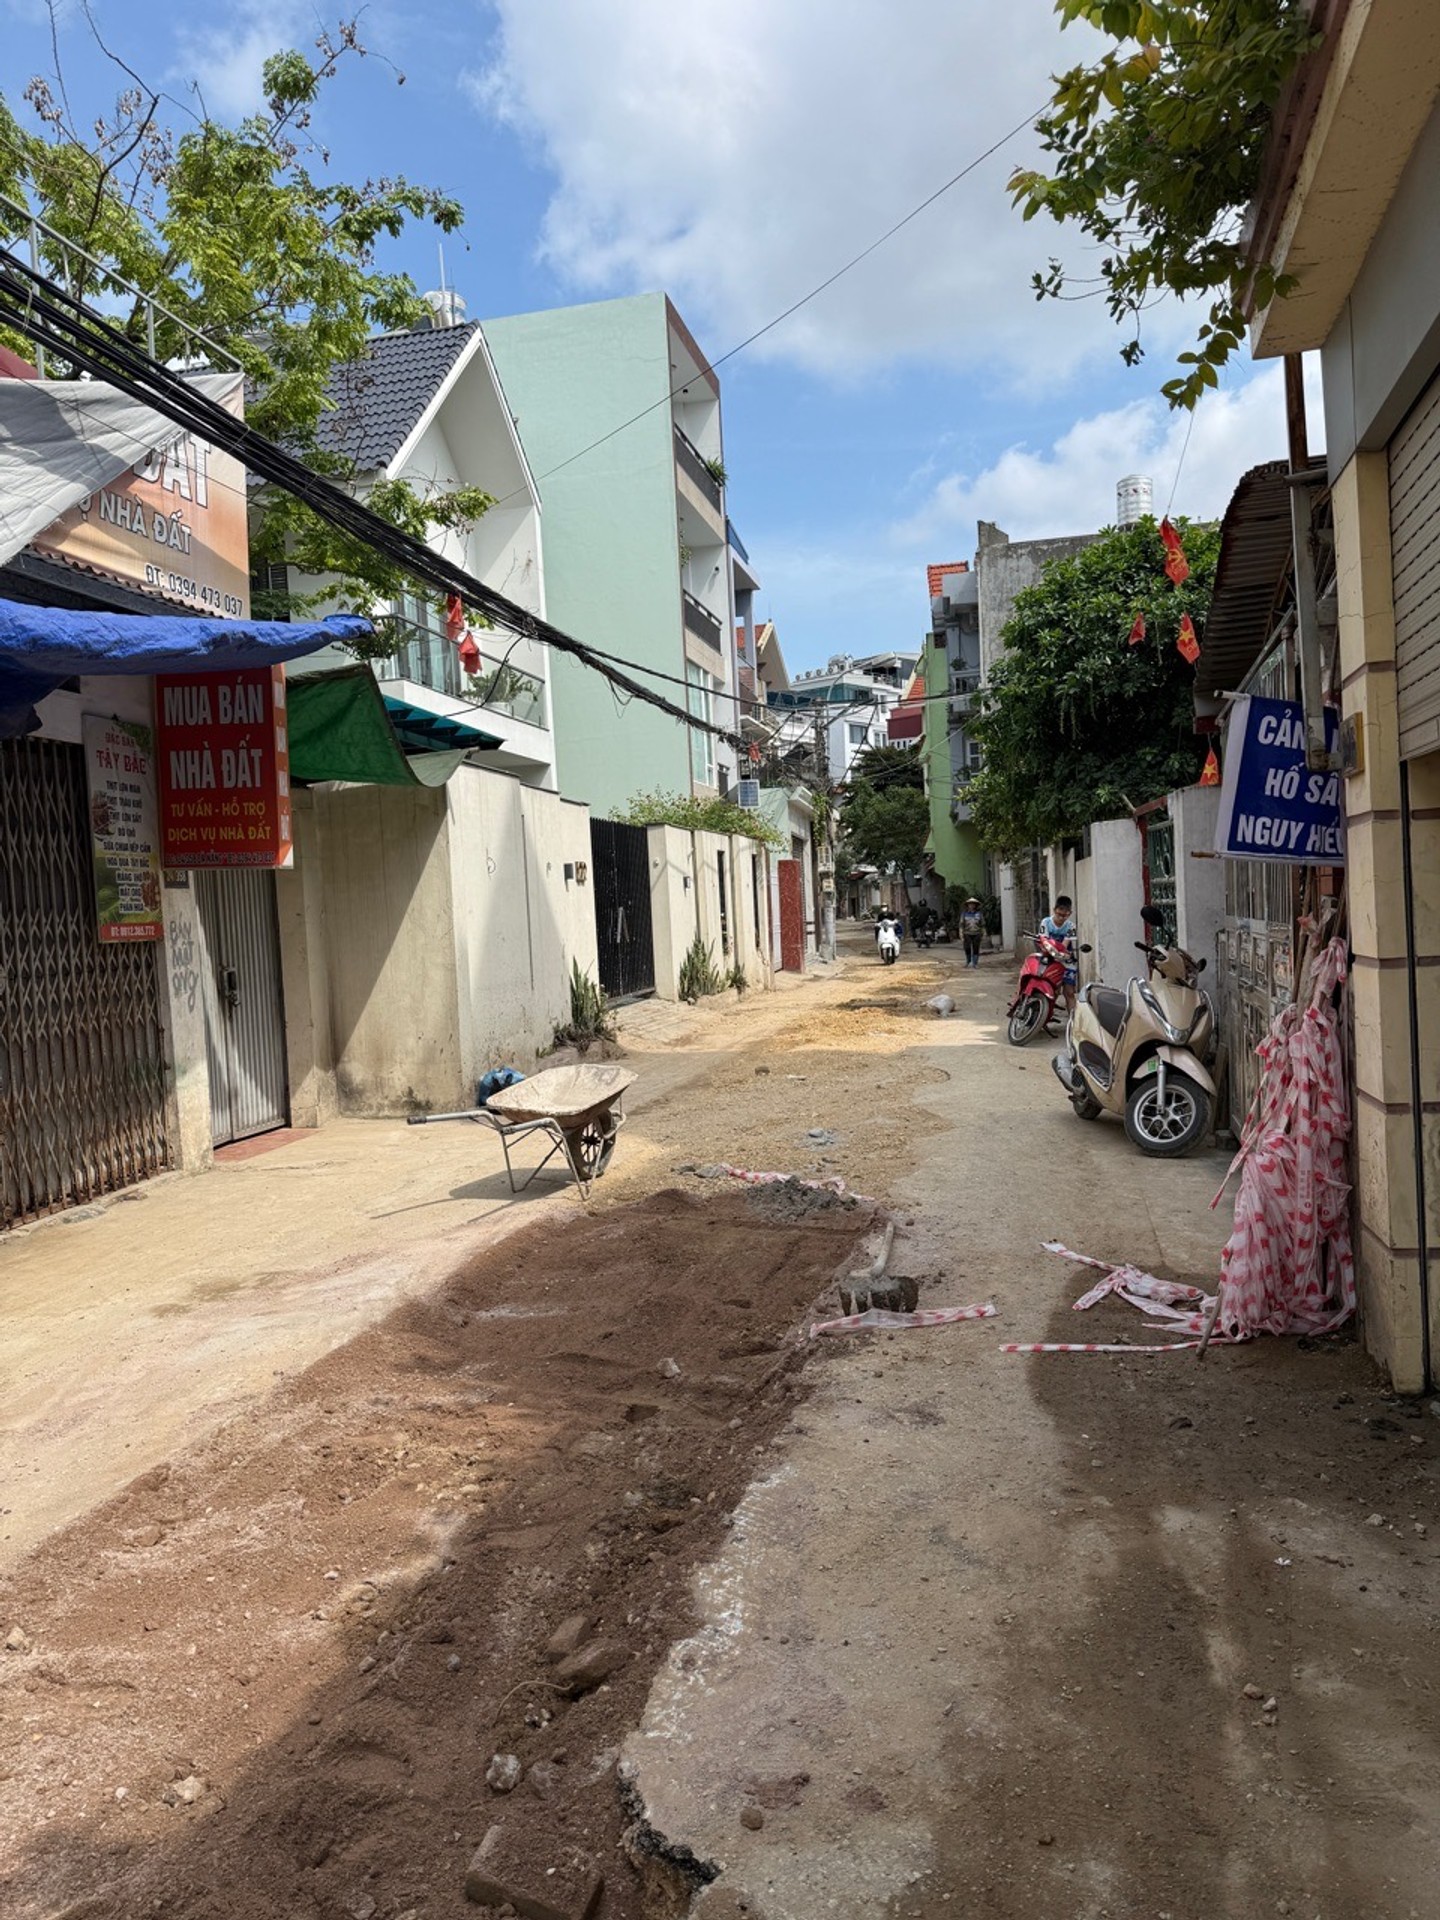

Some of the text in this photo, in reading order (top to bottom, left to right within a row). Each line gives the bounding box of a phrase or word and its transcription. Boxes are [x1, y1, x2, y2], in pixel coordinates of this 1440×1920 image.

[100, 489, 149, 537] NHÀ
[153, 508, 192, 555] ĐẤT
[145, 563, 243, 616] ĐT: 0394 473 037
[163, 675, 264, 726] MUA BÁN
[1258, 708, 1305, 751] CẢN
[96, 747, 119, 769] TÂY
[169, 733, 263, 790] NHÀ ĐẤT
[1265, 762, 1341, 807] HỐ SÂ
[171, 802, 185, 817] TƯ
[187, 797, 213, 817] VẤN
[221, 796, 240, 816] HỖ
[243, 801, 266, 819] TRỢ
[168, 820, 271, 845] DỊCH VỤ NHÀ ĐẤT
[1236, 813, 1305, 849] NGUY
